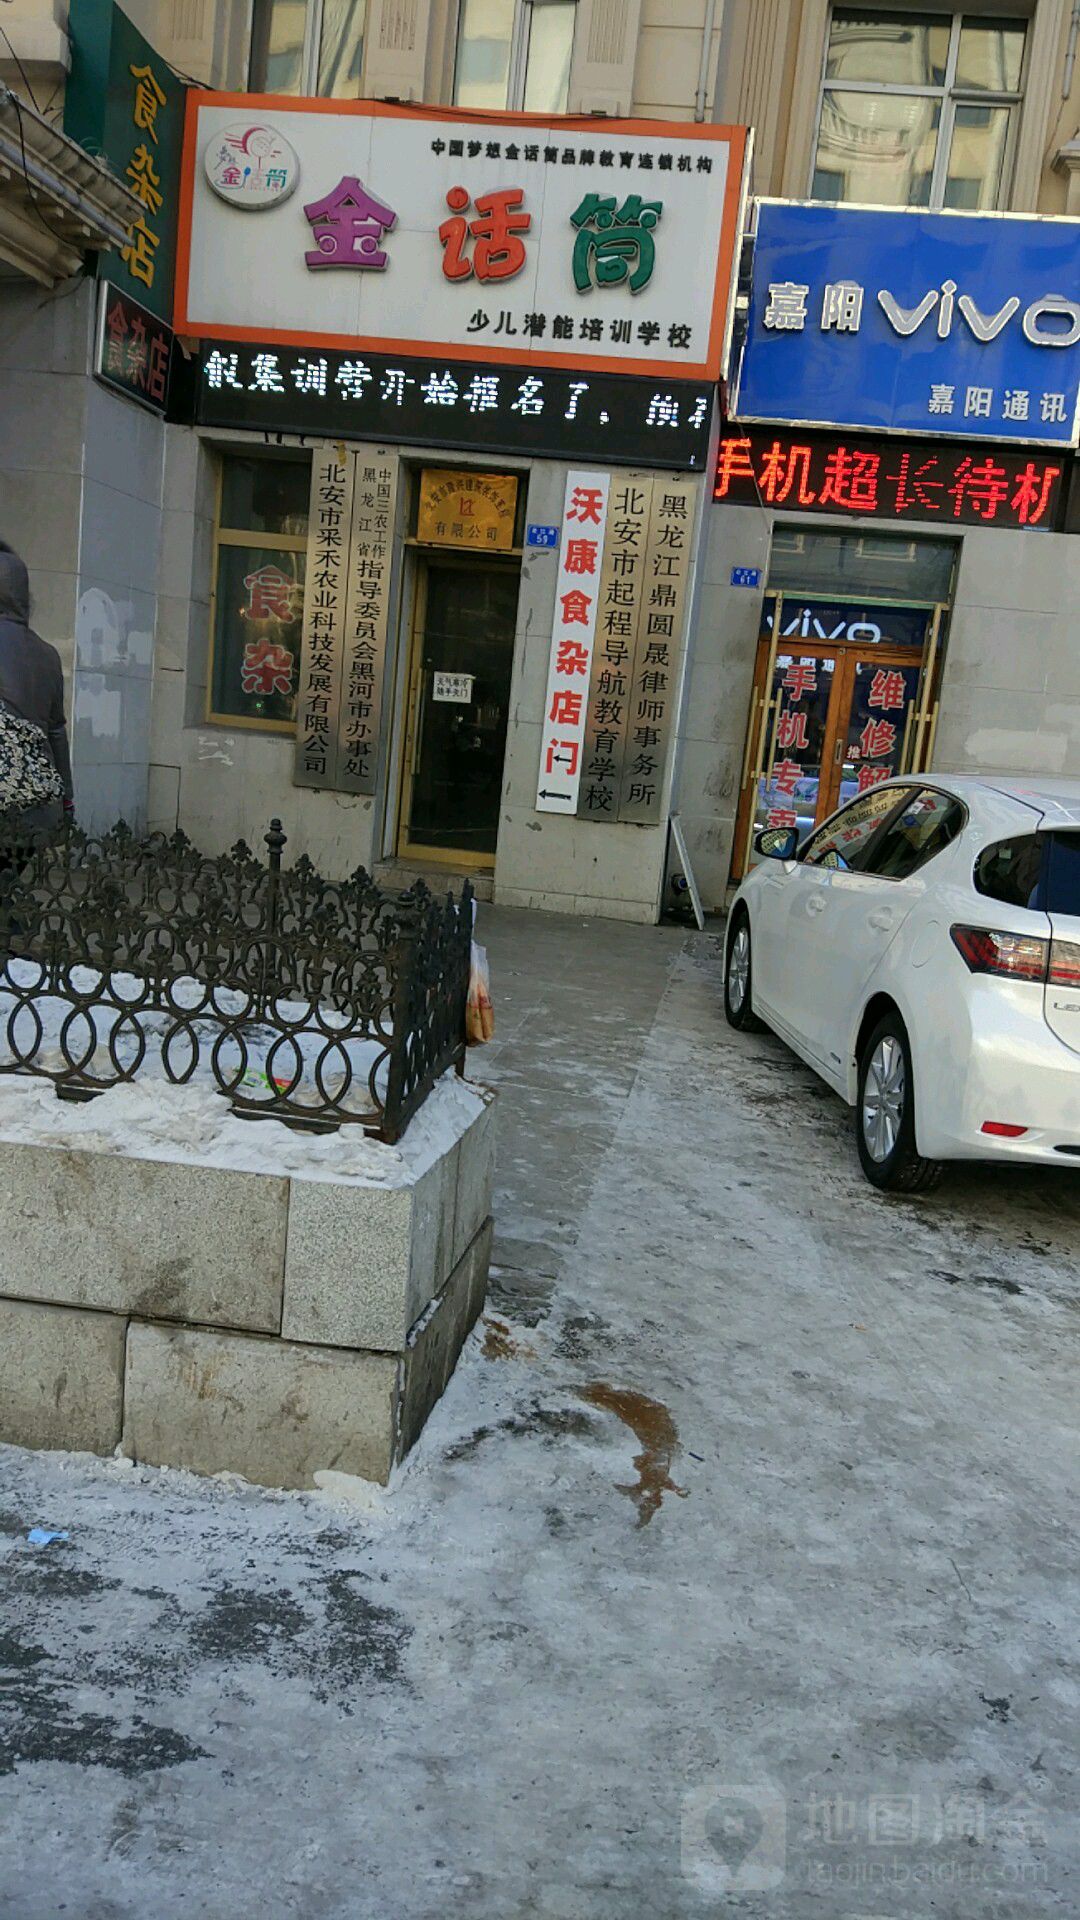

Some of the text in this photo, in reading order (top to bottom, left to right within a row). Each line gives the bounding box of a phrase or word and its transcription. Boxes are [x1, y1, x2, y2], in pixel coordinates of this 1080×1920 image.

[119, 64, 167, 288] 食杂店
[431, 138, 713, 174] 中国梦想金话筒品牌教育连锁机构
[305, 176, 664, 296] 金话筒
[466, 309, 693, 350] 少儿潜能培训学校
[763, 279, 1080, 347] 嘉阳 vivo
[928, 384, 1068, 423] 嘉阳通讯
[356, 466, 378, 558] 黑龙江省
[371, 468, 392, 560] 中国三农工作
[435, 521, 498, 541] 有限公司
[536, 533, 549, 545] 59
[242, 565, 298, 697] 食杂
[343, 560, 385, 779] 指导委员会黑河市办事处
[545, 486, 604, 776] 沃康食杂店门
[586, 488, 645, 812] 北安市起程导航教育学校
[626, 494, 688, 806] 黑龙江鼎圆晟律师事务所
